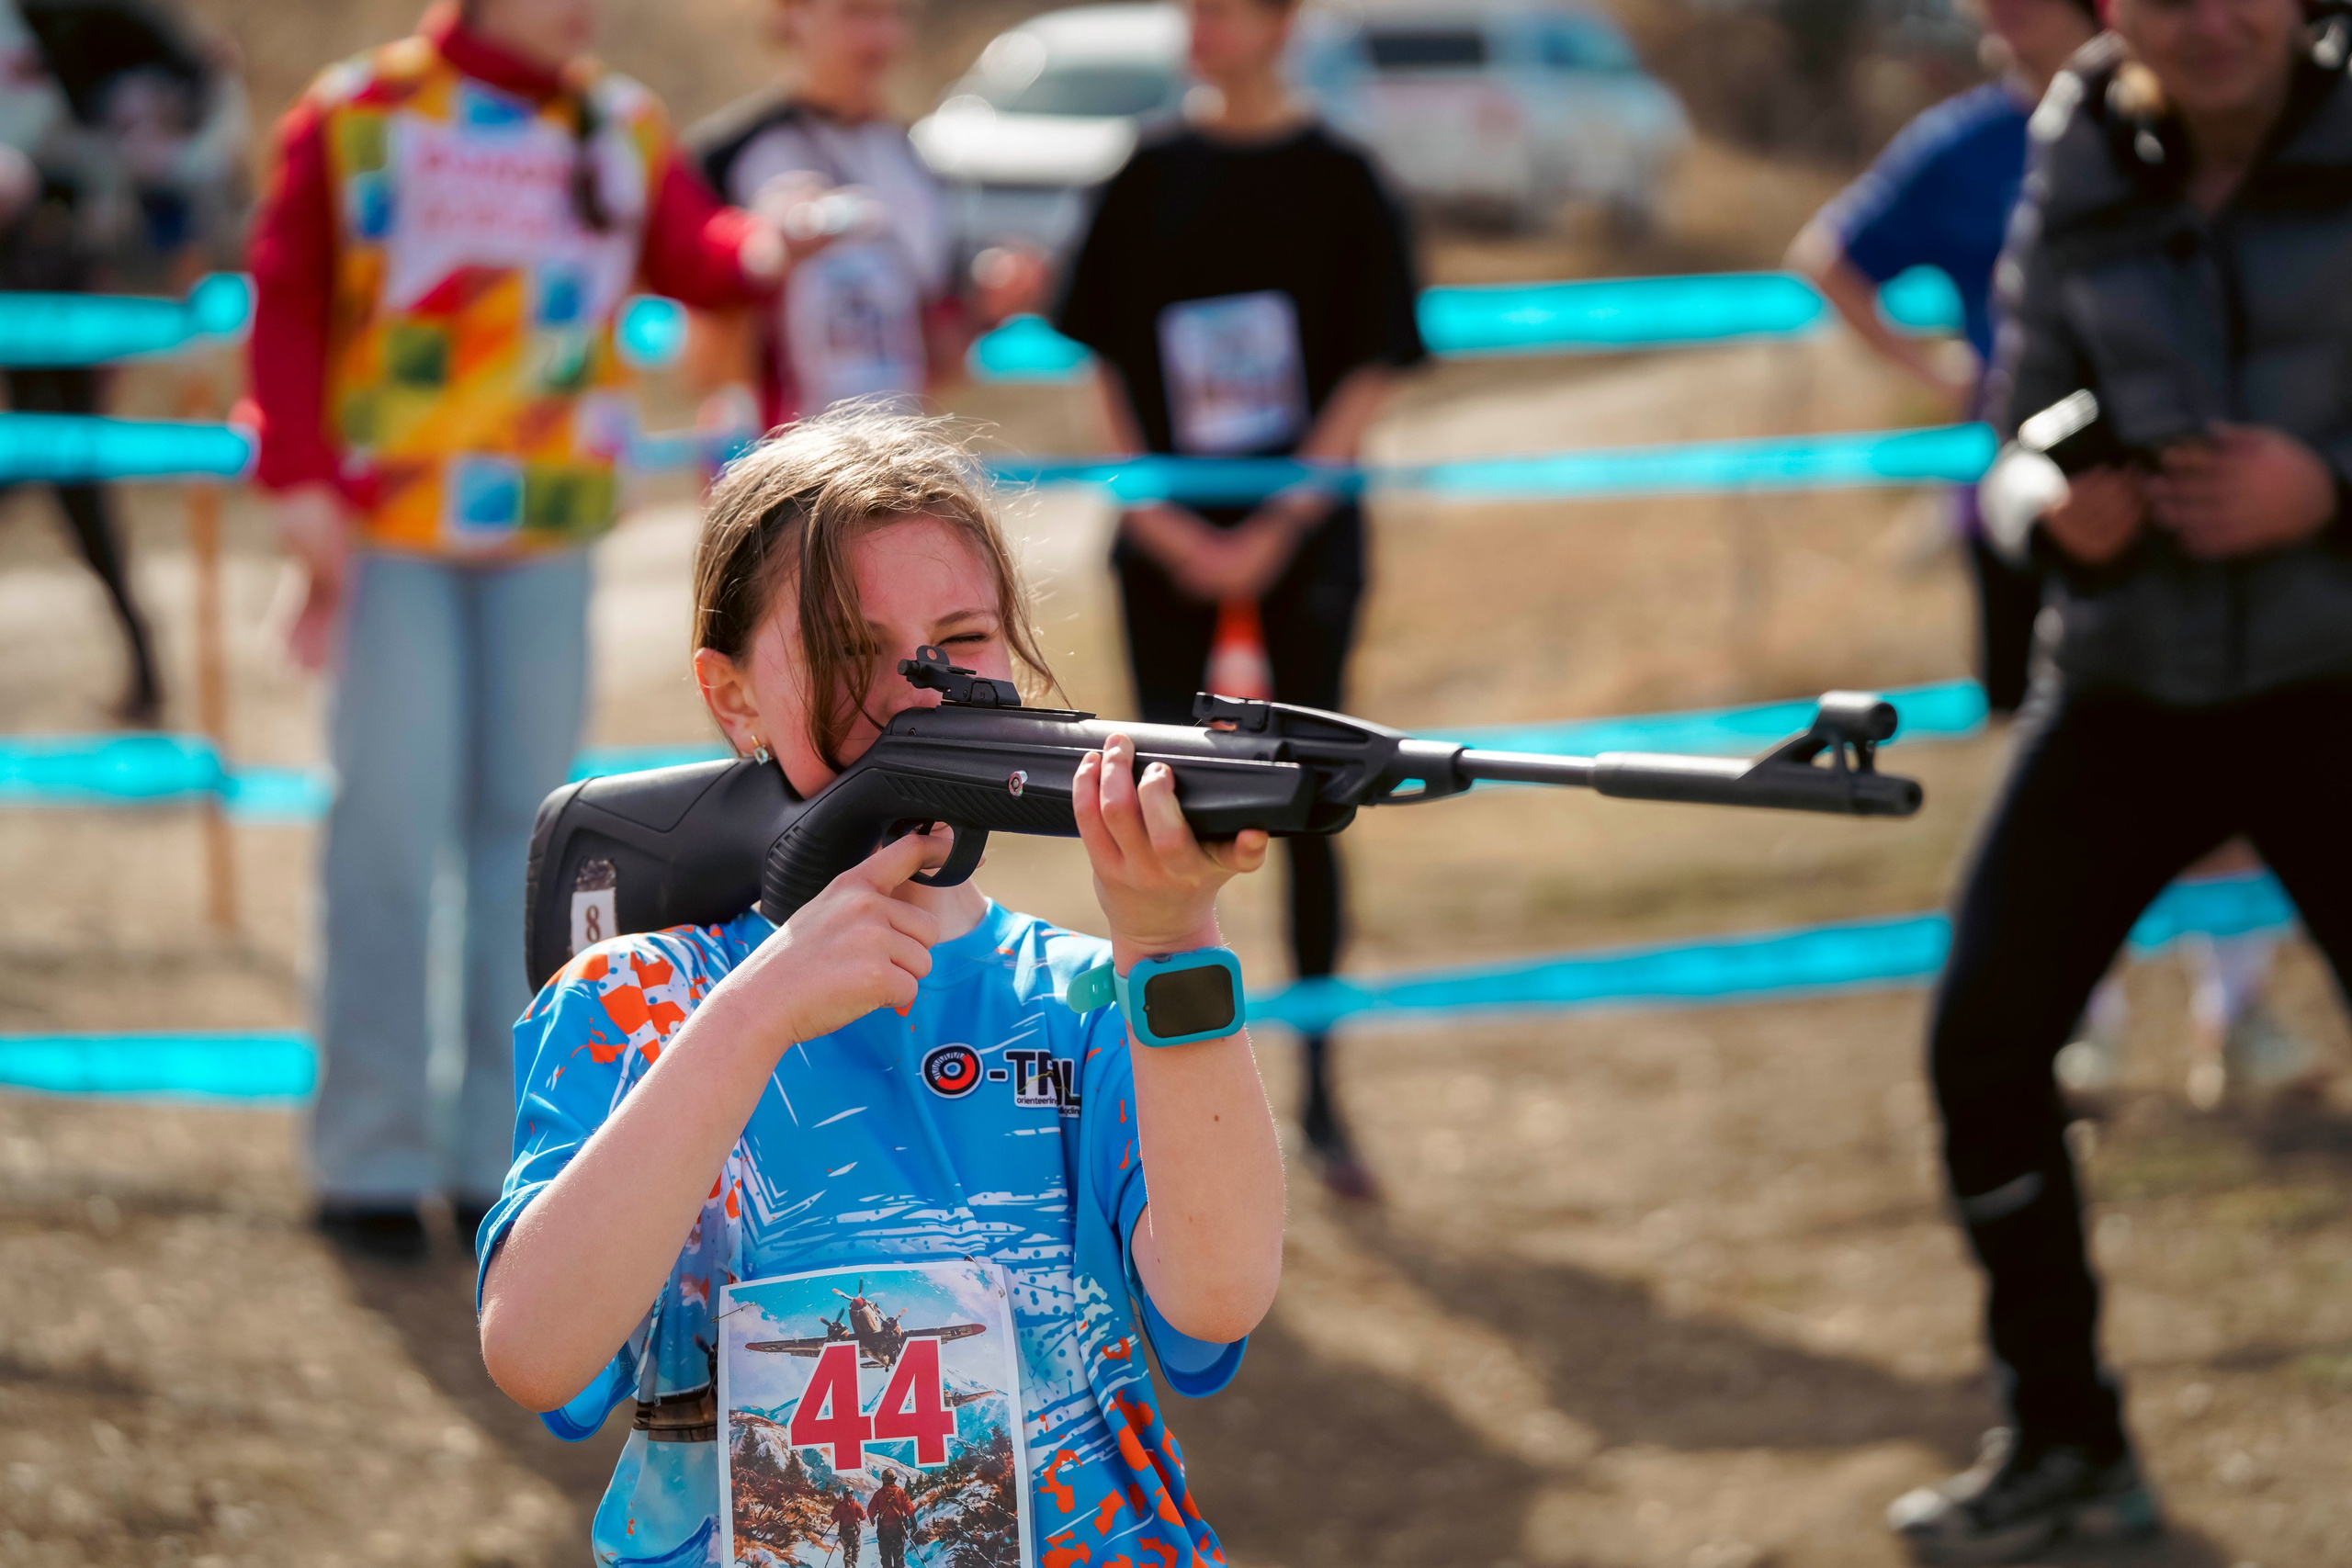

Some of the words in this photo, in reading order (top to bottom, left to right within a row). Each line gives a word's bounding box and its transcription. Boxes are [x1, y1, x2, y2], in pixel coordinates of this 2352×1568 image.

[586, 905, 600, 942] 8
[1017, 1096, 1058, 1105] orienteerin
[789, 1337, 957, 1472] 44
